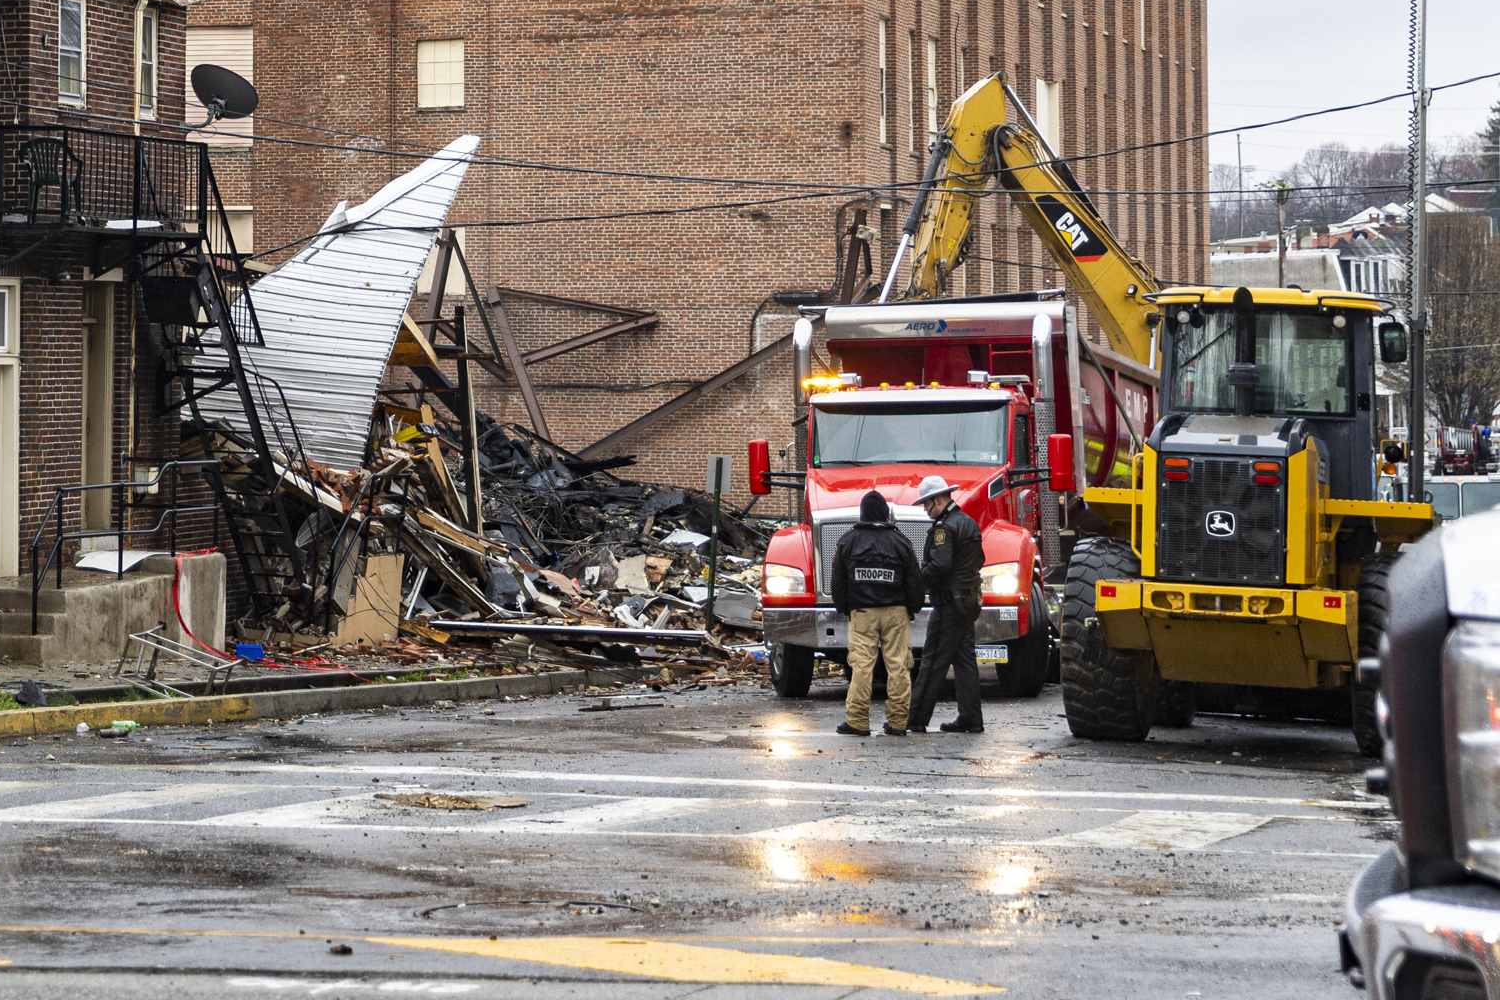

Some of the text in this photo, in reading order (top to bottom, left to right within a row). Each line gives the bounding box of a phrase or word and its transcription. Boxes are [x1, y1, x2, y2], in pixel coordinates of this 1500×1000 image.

[1055, 211, 1089, 251] CAT
[905, 322, 935, 331] AERO
[857, 570, 893, 580] TROOPER
